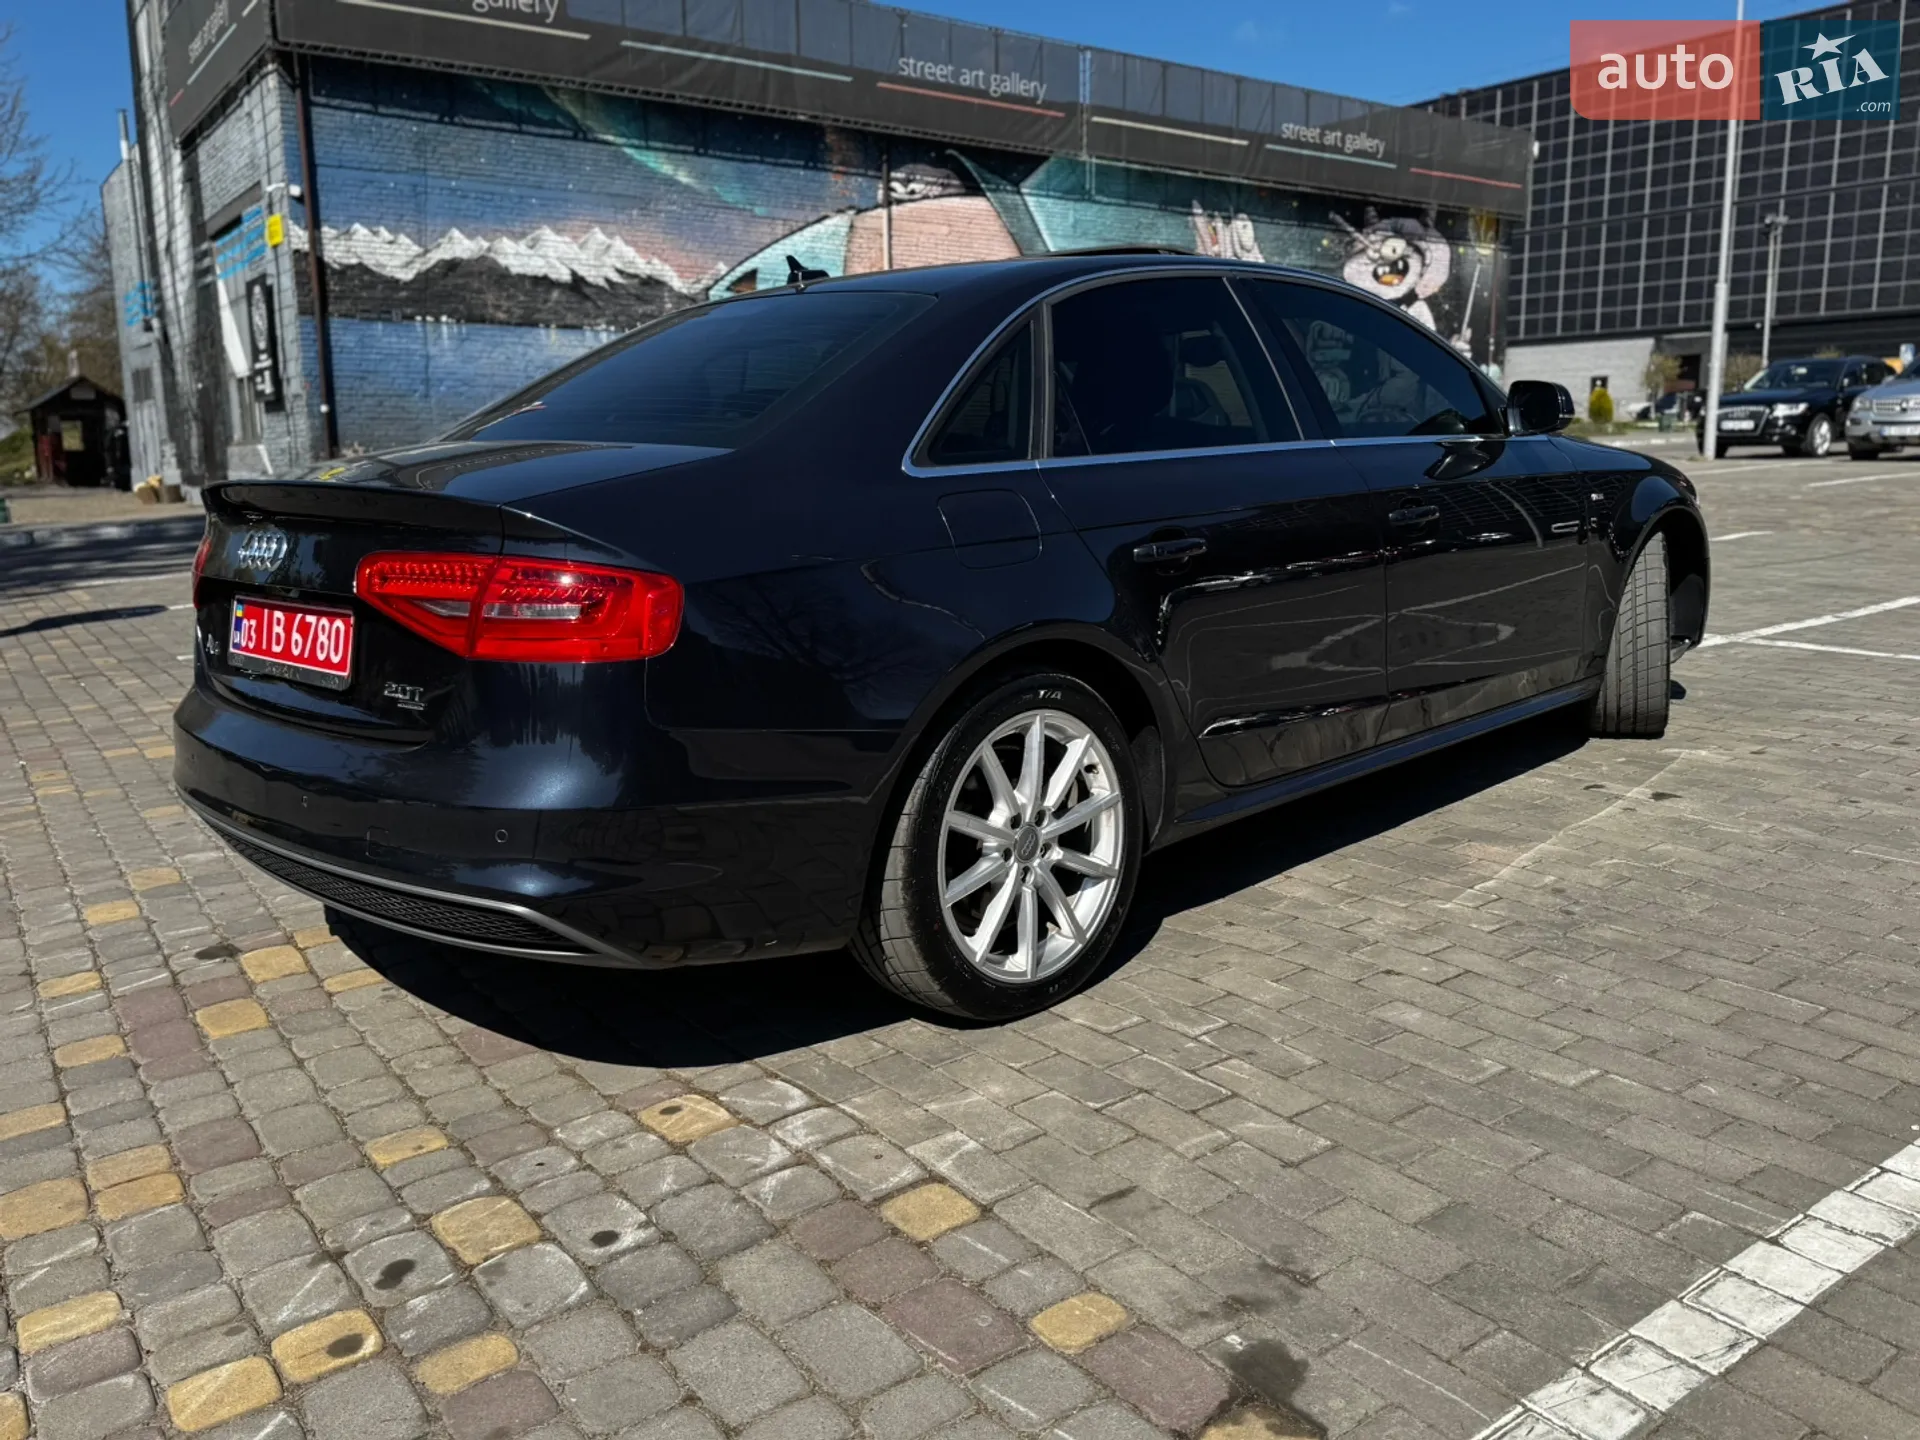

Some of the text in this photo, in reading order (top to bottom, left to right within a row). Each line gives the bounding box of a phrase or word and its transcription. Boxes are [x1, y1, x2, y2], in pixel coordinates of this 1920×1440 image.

[898, 56, 1047, 105] street art gallery
[1281, 122, 1386, 159] street art gallery
[241, 608, 345, 664] 03 IB 6780
